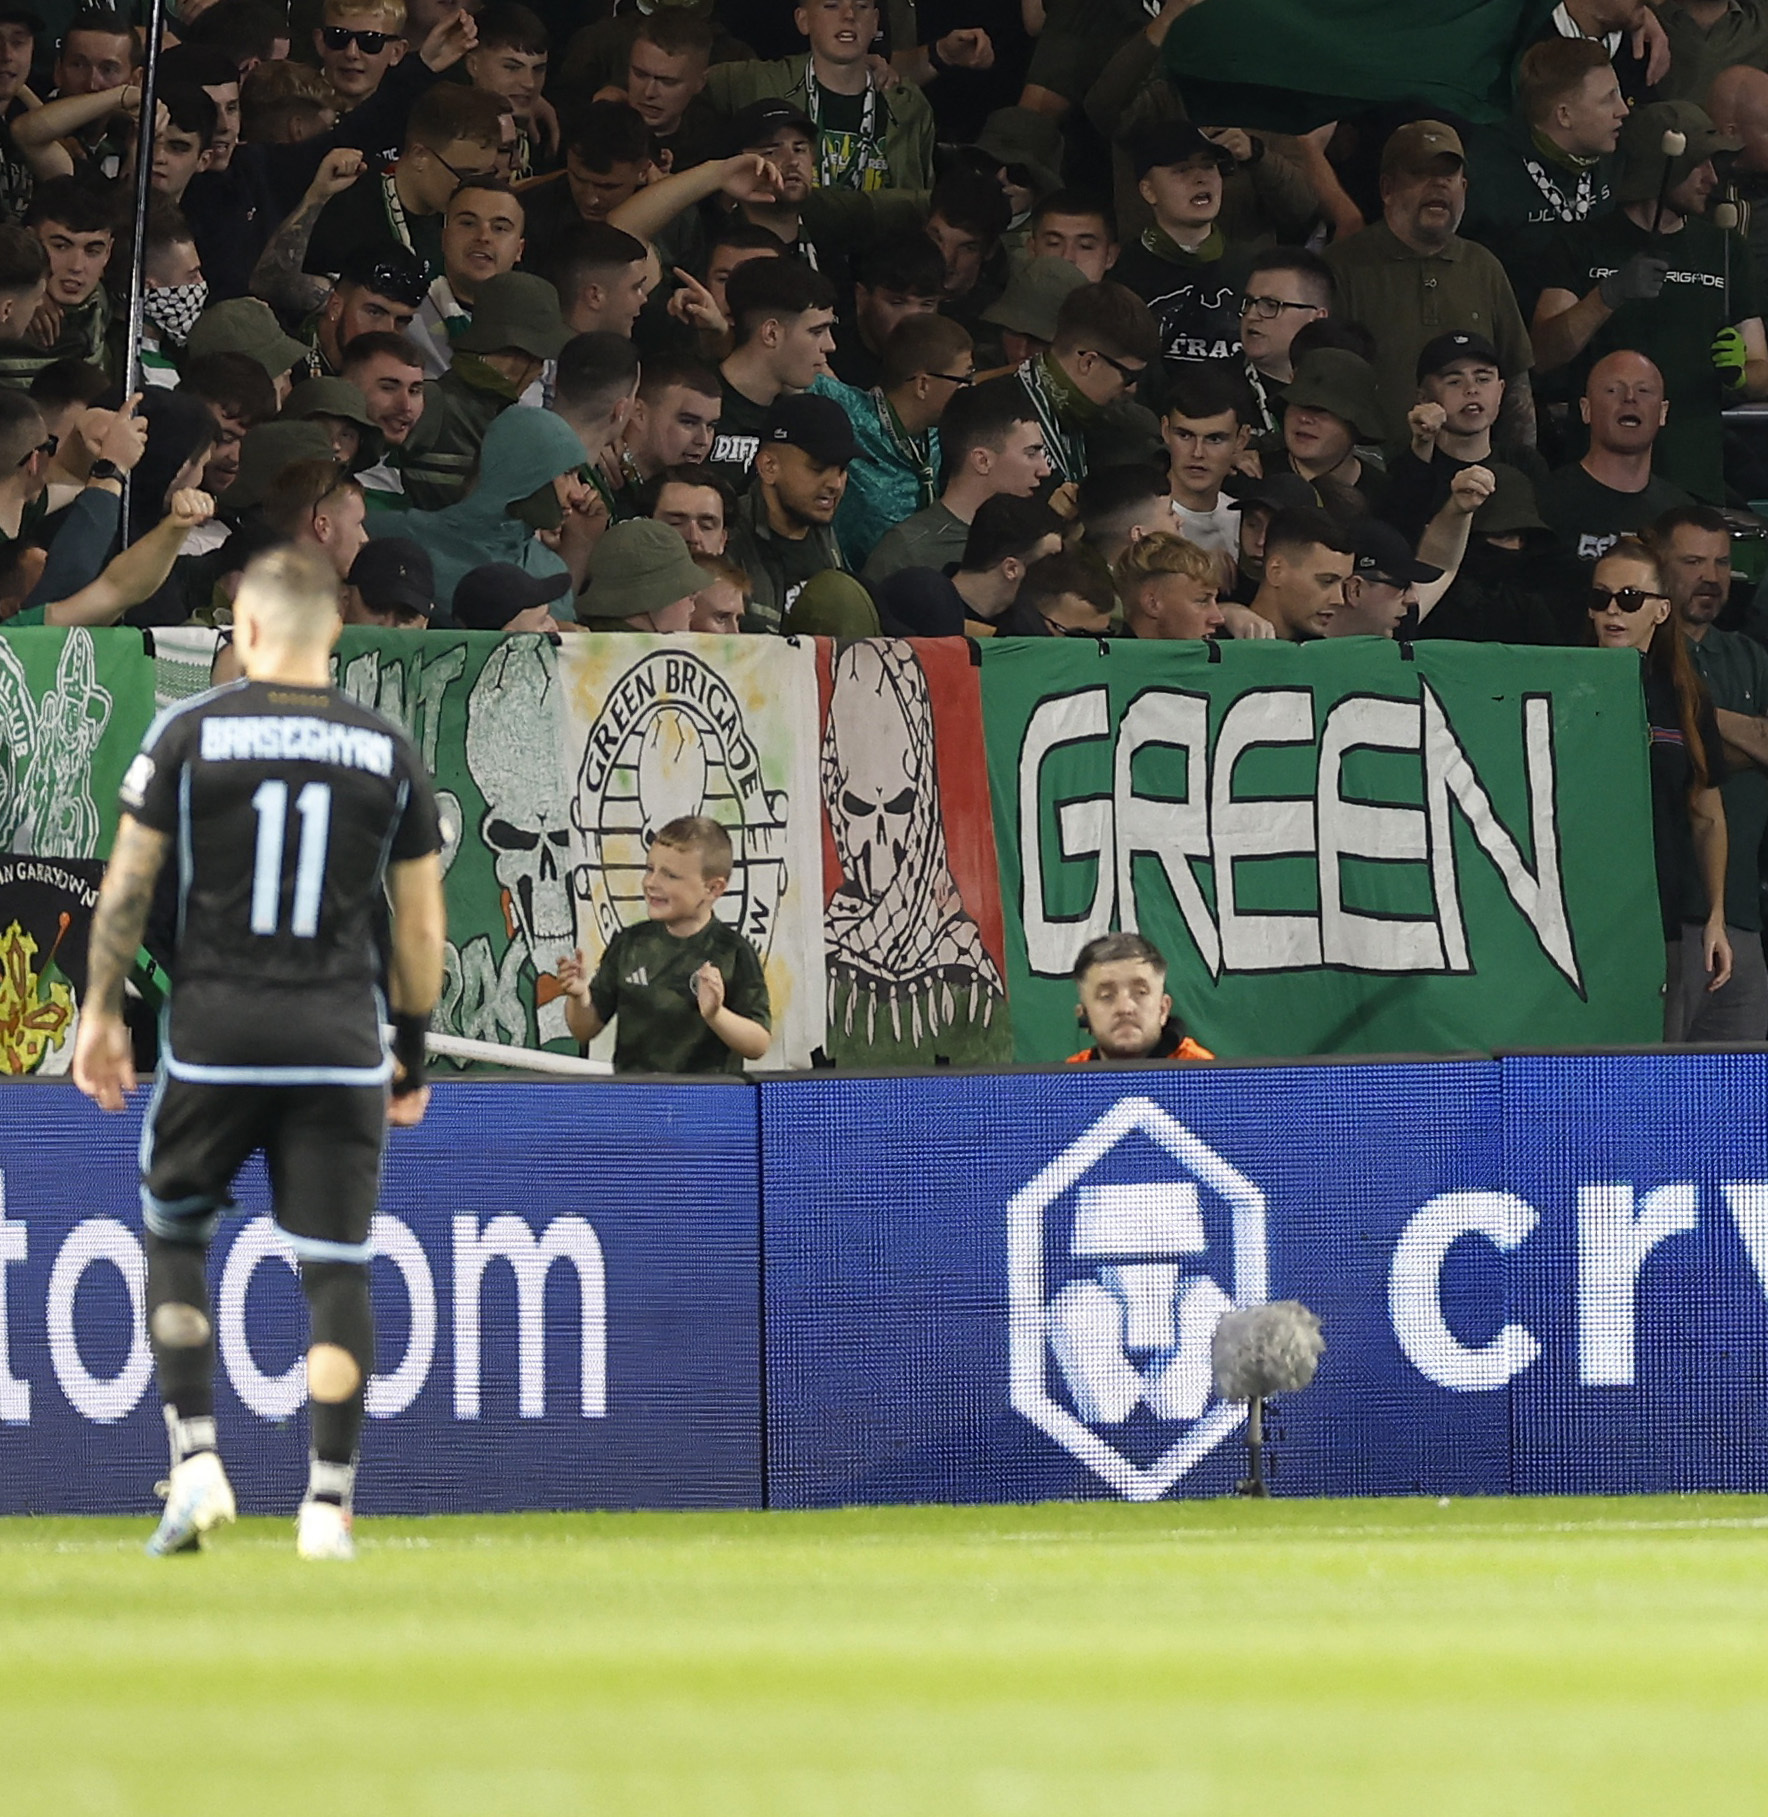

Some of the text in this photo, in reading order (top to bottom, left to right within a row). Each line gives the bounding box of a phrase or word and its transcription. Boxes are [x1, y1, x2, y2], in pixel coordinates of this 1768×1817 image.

[587, 668, 657, 793] GREEN
[665, 658, 760, 801] BRIGADE
[249, 779, 333, 940] 11
[1018, 673, 1588, 1003] GREEN
